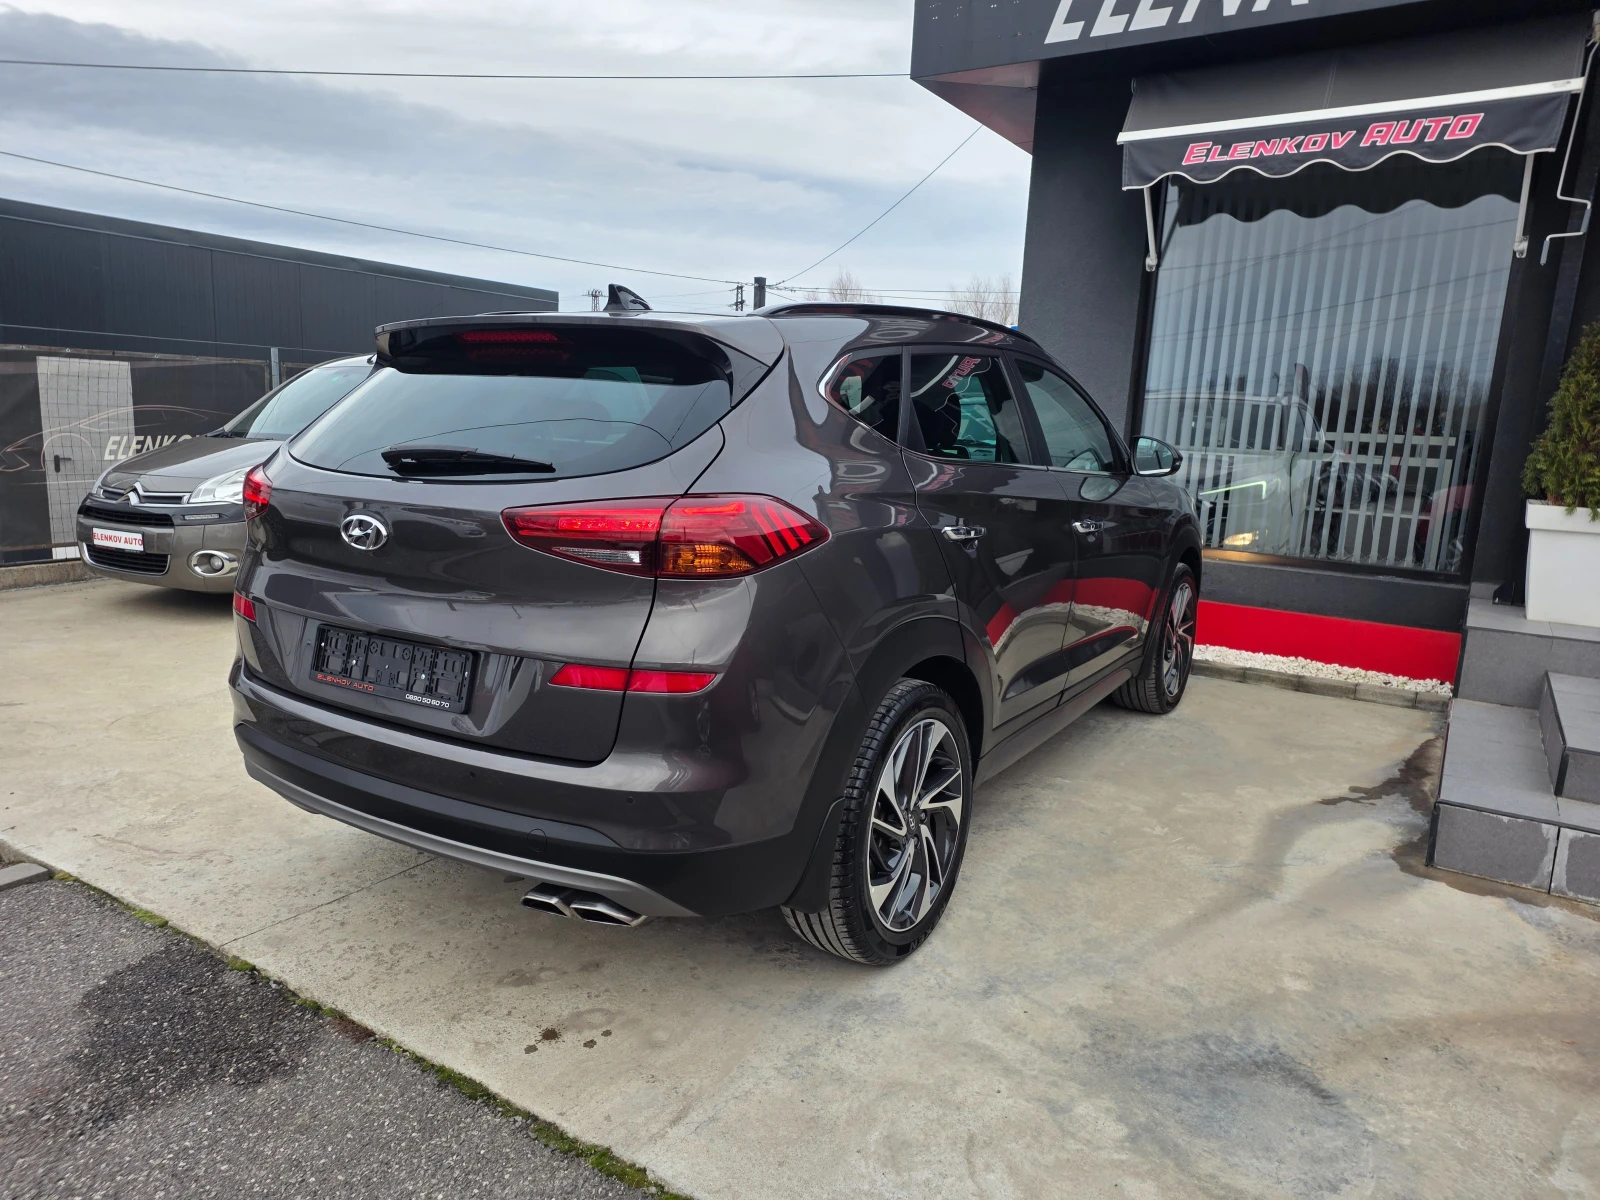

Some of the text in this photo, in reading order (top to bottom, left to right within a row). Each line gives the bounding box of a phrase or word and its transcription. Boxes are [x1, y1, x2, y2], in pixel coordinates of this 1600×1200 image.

[1182, 113, 1485, 165] ELENKOV AUTO
[93, 532, 144, 546] ELENKOV AUTO
[353, 682, 374, 691] AUTO
